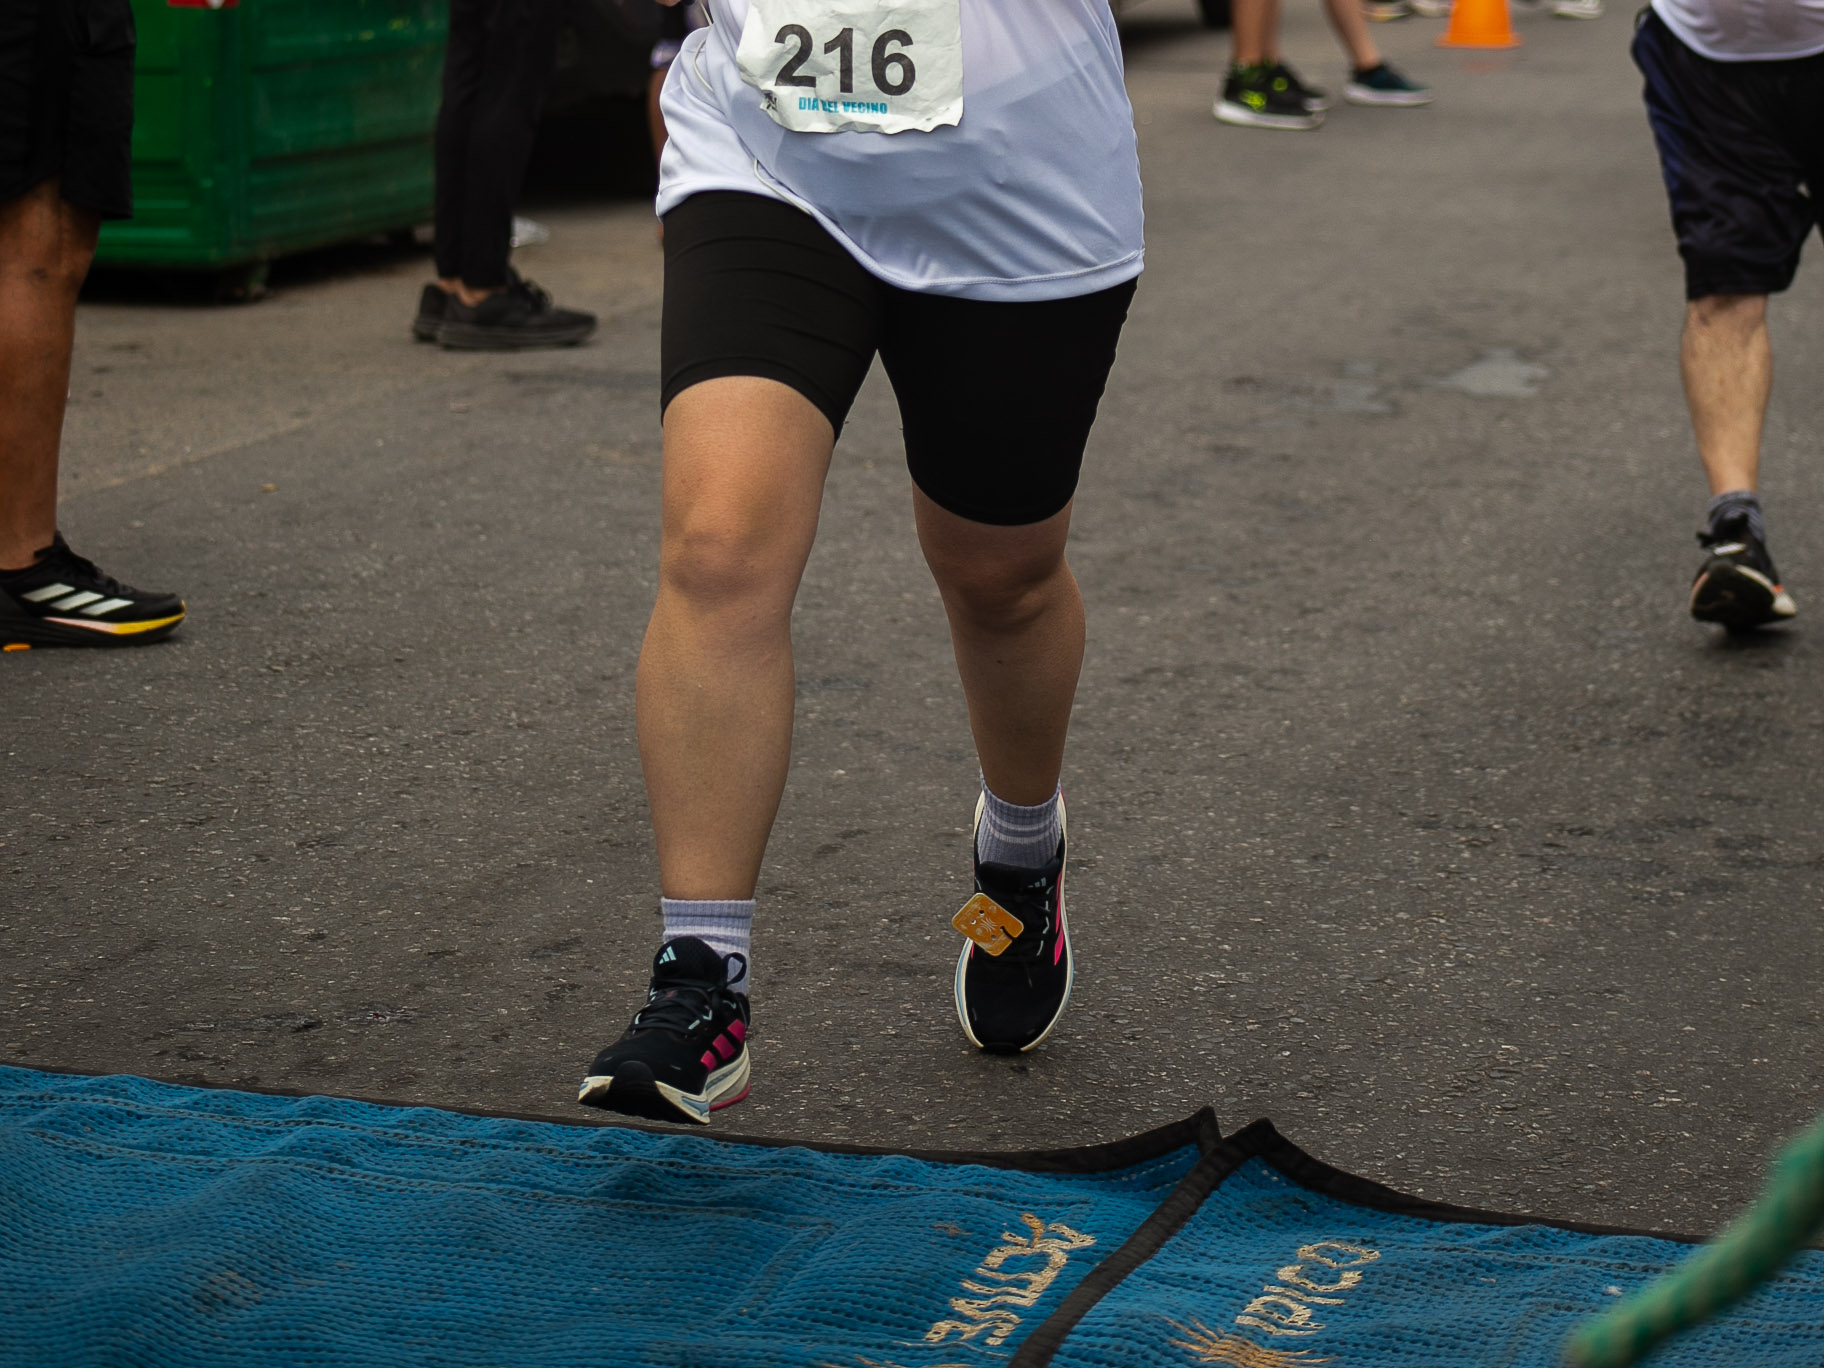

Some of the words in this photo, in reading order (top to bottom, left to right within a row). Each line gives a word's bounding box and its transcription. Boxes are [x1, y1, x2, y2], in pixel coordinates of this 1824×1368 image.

[774, 23, 917, 97] 216
[798, 96, 820, 111] DIA
[842, 100, 888, 115] VECINO
[1235, 1240, 1382, 1336] IPICO
